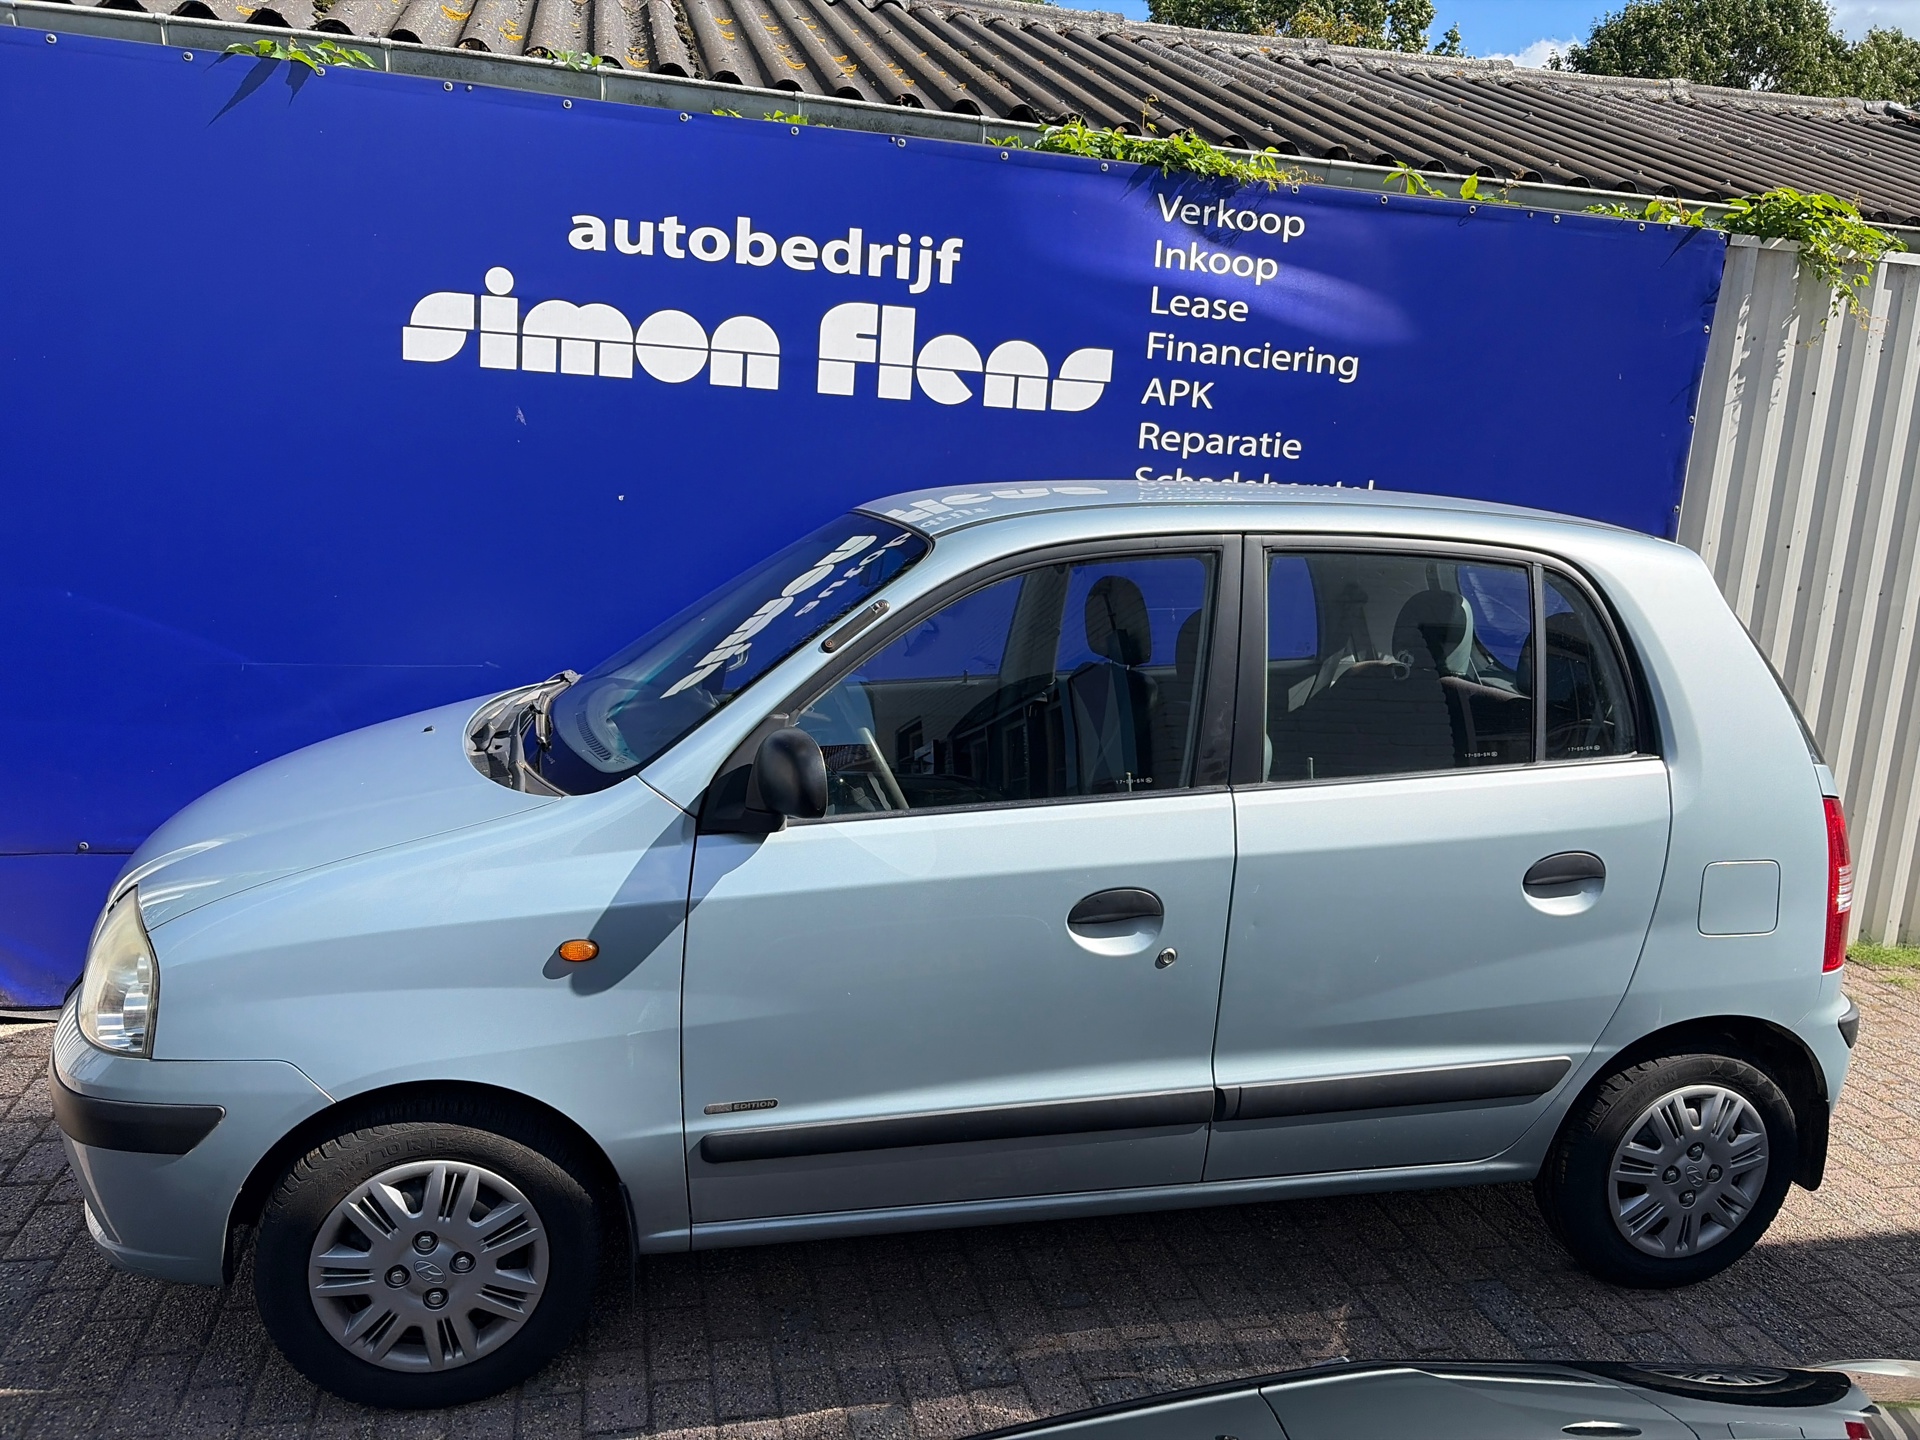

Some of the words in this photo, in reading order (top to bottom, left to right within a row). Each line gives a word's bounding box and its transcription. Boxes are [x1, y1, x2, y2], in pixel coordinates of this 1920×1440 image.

[1157, 193, 1305, 243] Verkoop
[568, 214, 964, 294] autobedrijf
[1154, 239, 1279, 286] Inkoop
[1150, 286, 1249, 322] Lease
[403, 266, 780, 391] simon
[817, 302, 1114, 412] flens
[1146, 331, 1359, 384] Financiering
[1140, 377, 1215, 410] APK
[1138, 422, 1302, 459] Reparatie
[733, 1100, 775, 1110] EDITION
